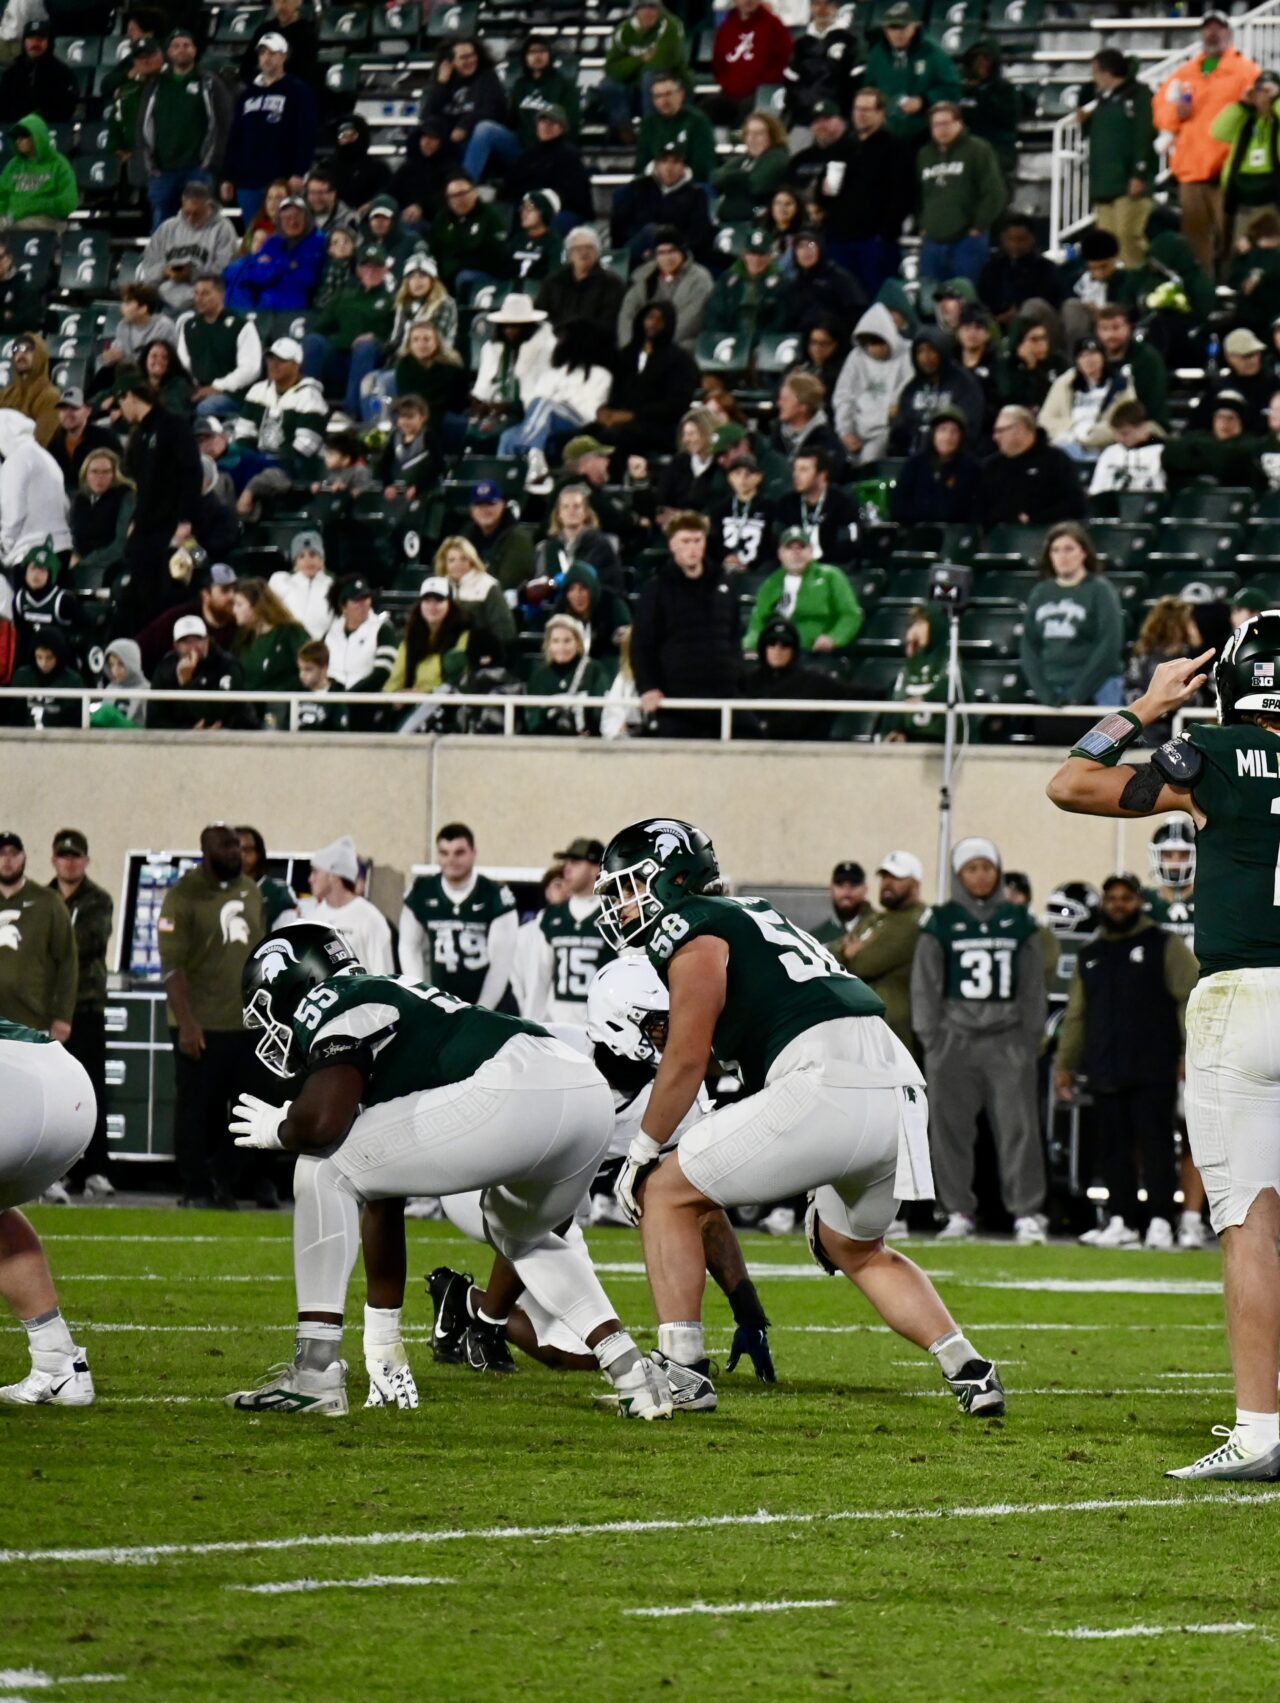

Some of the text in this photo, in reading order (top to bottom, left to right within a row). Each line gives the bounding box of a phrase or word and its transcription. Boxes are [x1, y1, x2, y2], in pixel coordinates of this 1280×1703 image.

[434, 926, 490, 973] 49
[650, 913, 690, 959] 58
[557, 947, 600, 995] 15
[960, 950, 1012, 999] 31
[293, 982, 340, 1031] 55
